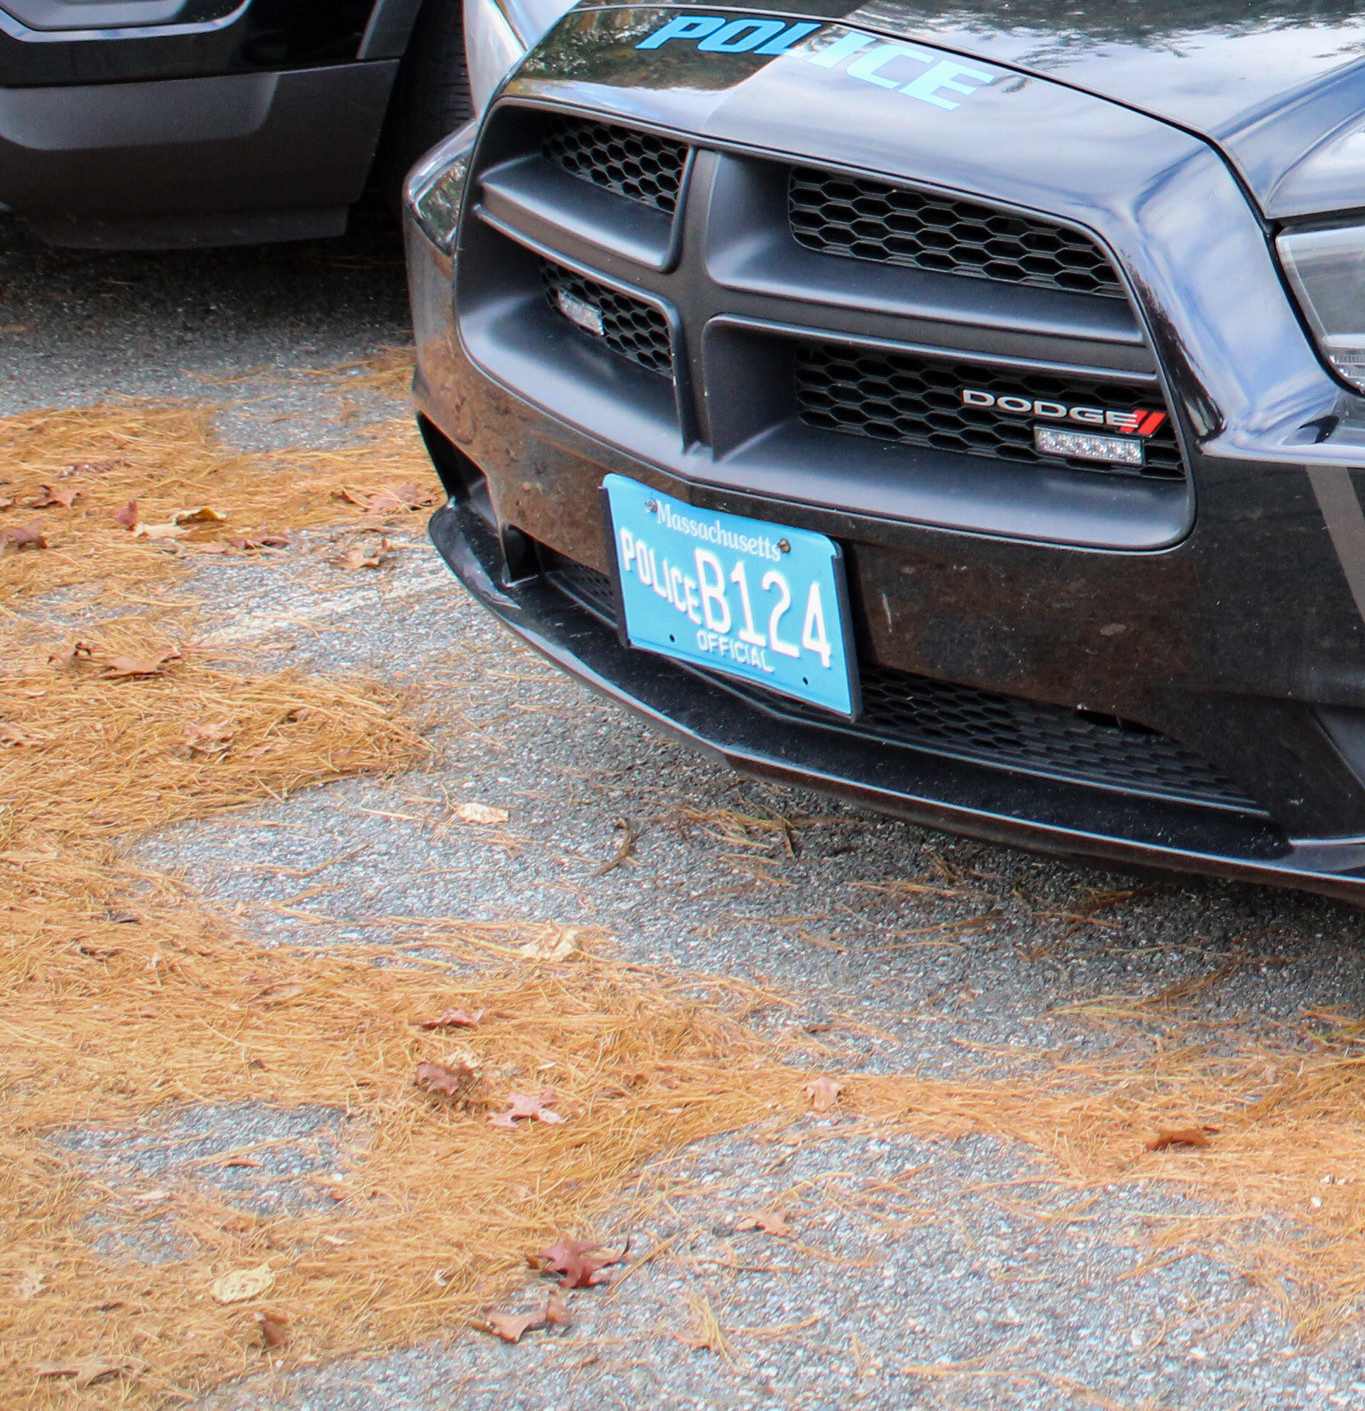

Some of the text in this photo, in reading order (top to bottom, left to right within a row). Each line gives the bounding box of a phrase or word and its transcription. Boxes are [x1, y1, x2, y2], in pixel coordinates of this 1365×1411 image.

[635, 15, 999, 111] POLICE
[962, 389, 1139, 429] DODGE
[655, 499, 782, 561] Massachusetts
[619, 526, 831, 669] POLICE B124
[696, 630, 775, 673] OFFICIAL
